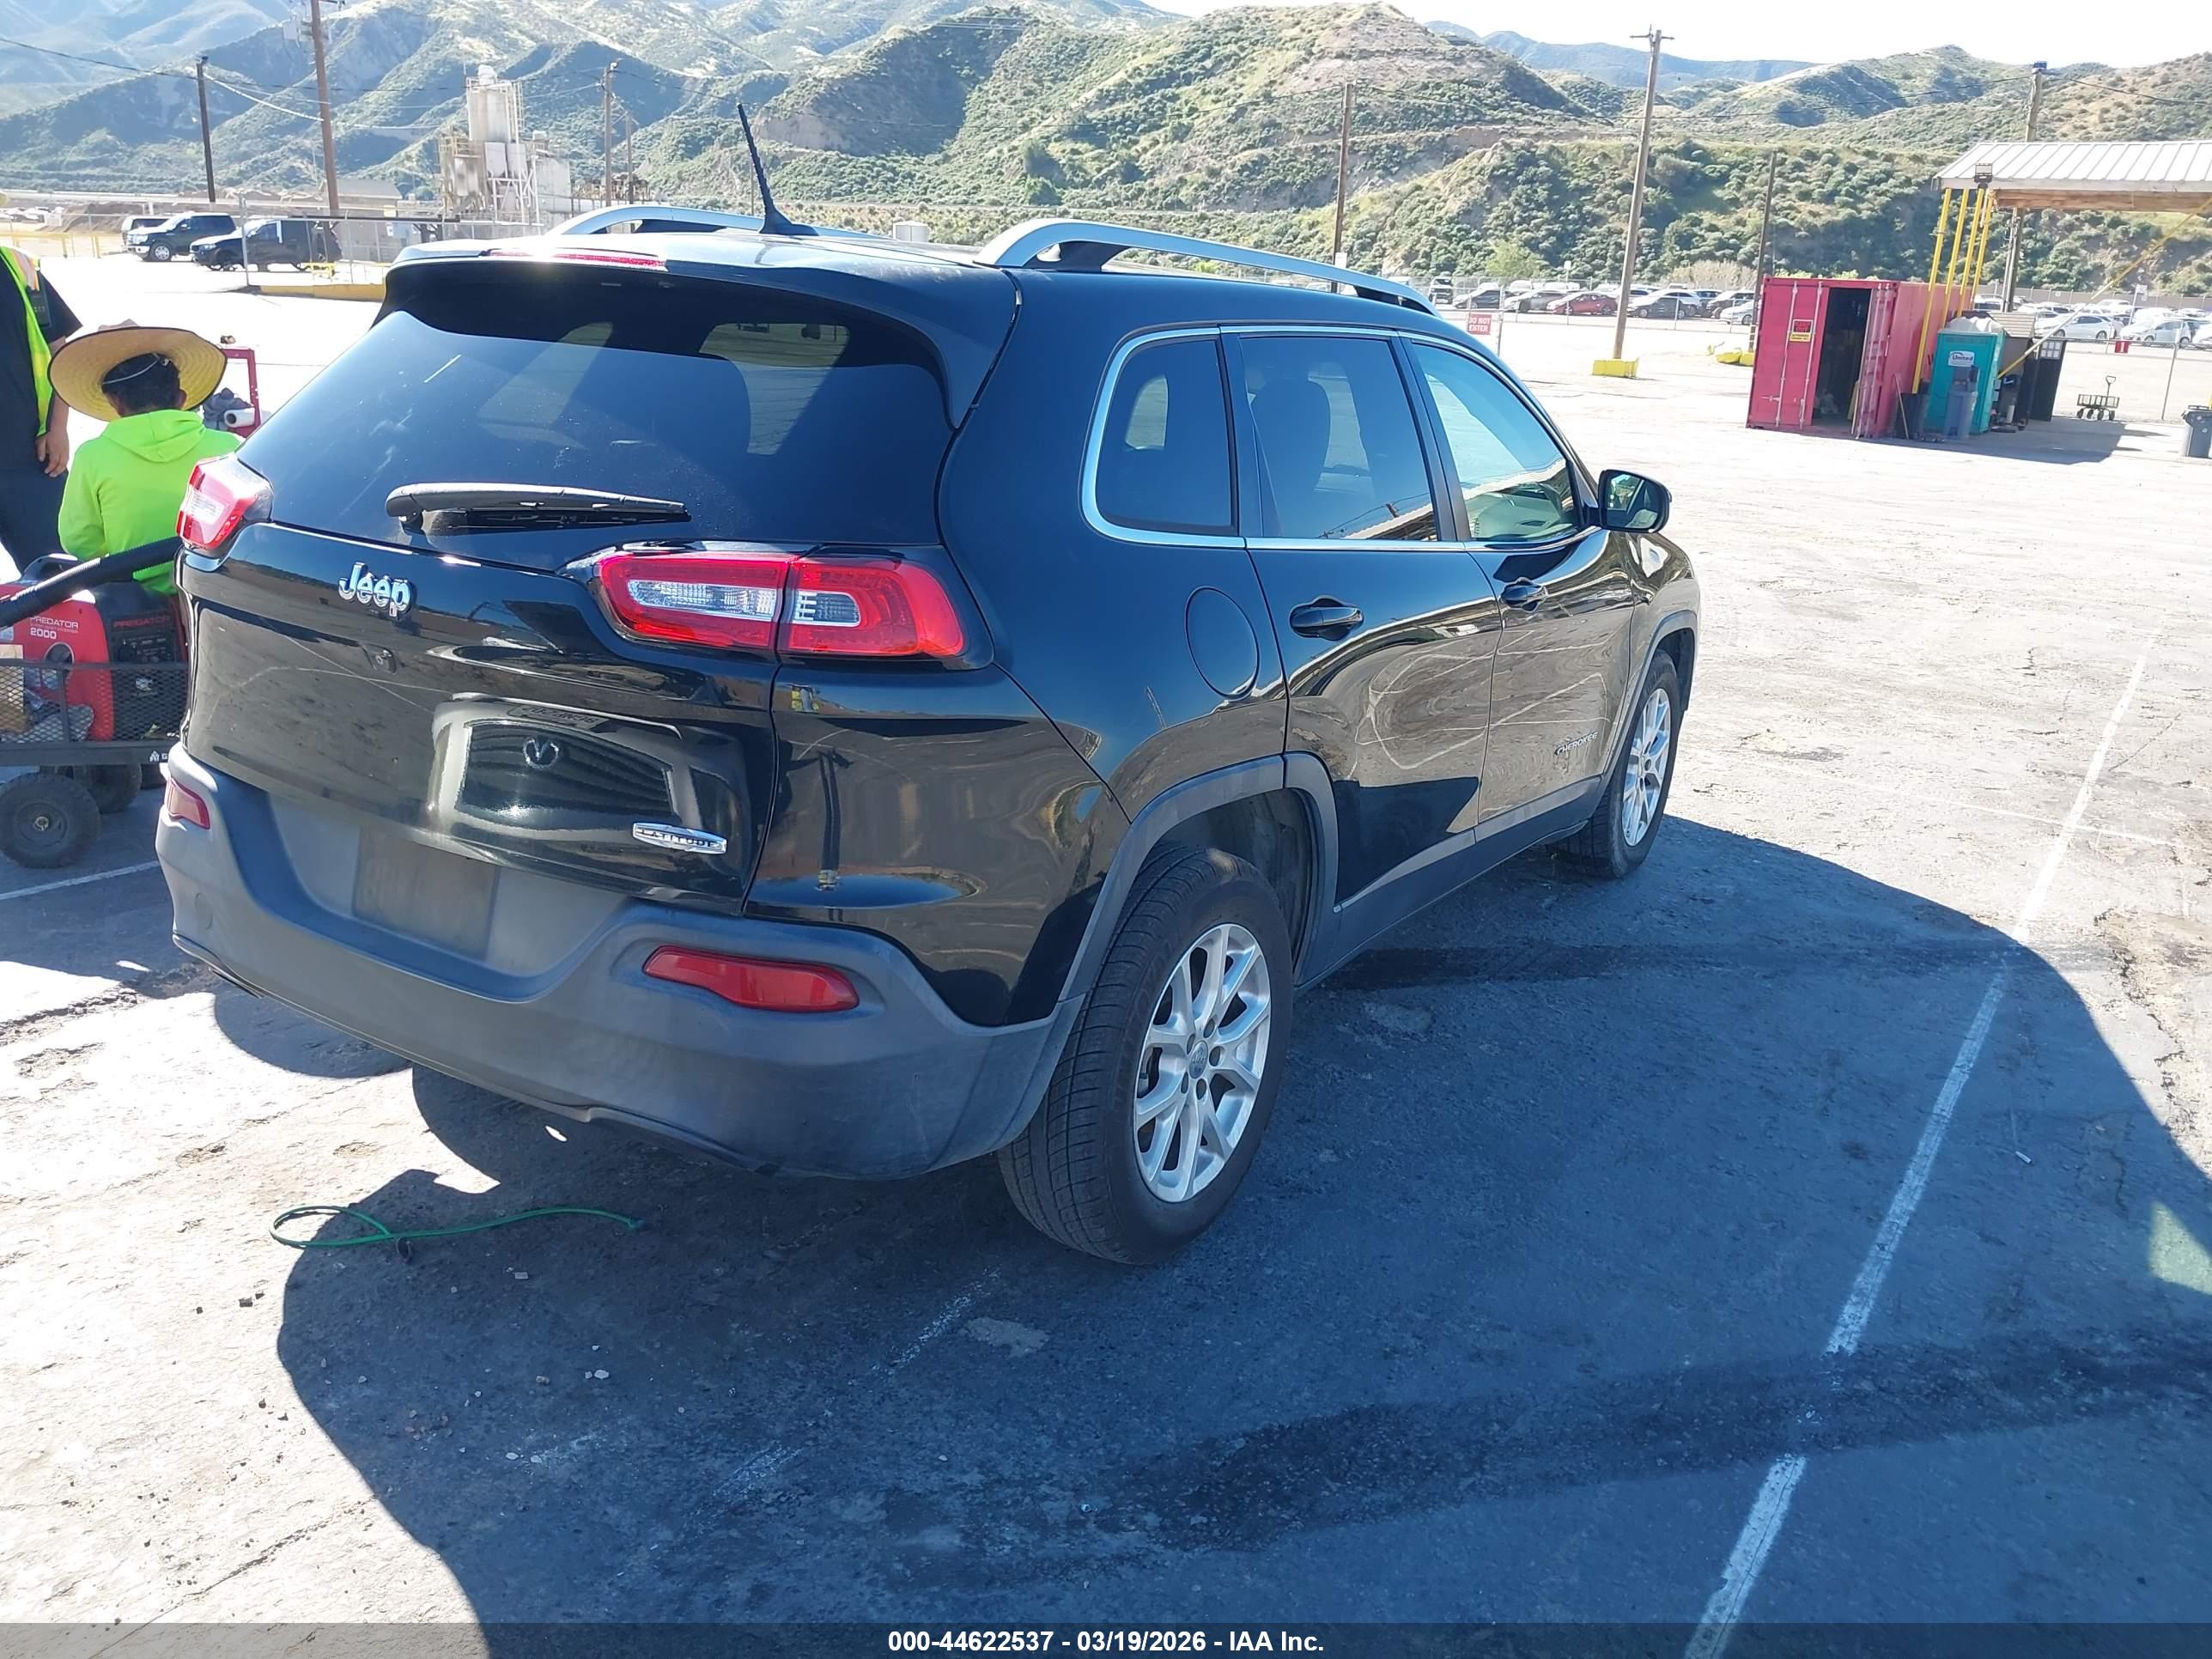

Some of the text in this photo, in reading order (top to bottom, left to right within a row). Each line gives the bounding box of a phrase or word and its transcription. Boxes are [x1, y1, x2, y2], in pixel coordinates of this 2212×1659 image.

[338, 562, 411, 617] Jeep
[30, 616, 79, 629] PREDATOR
[30, 627, 57, 640] 2000
[1557, 732, 1598, 755] CHEROKEE
[641, 829, 719, 848] LATITUDE
